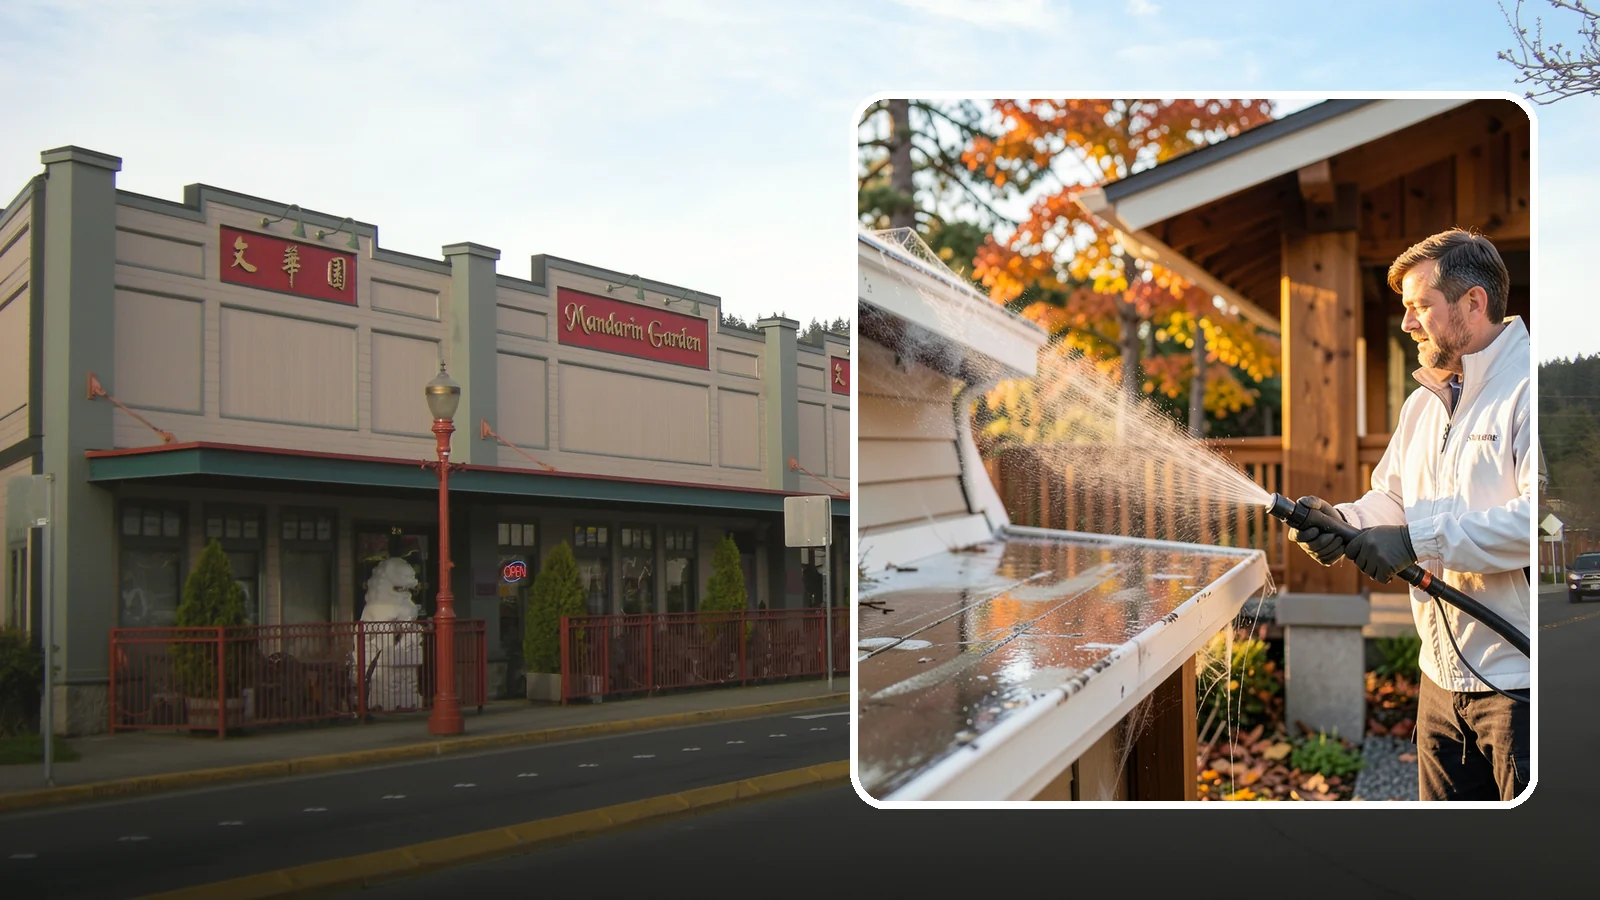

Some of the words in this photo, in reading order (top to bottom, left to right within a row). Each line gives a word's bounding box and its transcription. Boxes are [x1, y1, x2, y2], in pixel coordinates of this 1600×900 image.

[564, 302, 644, 341] Mandarin
[647, 320, 701, 352] Garden
[503, 565, 527, 578] OPEN
